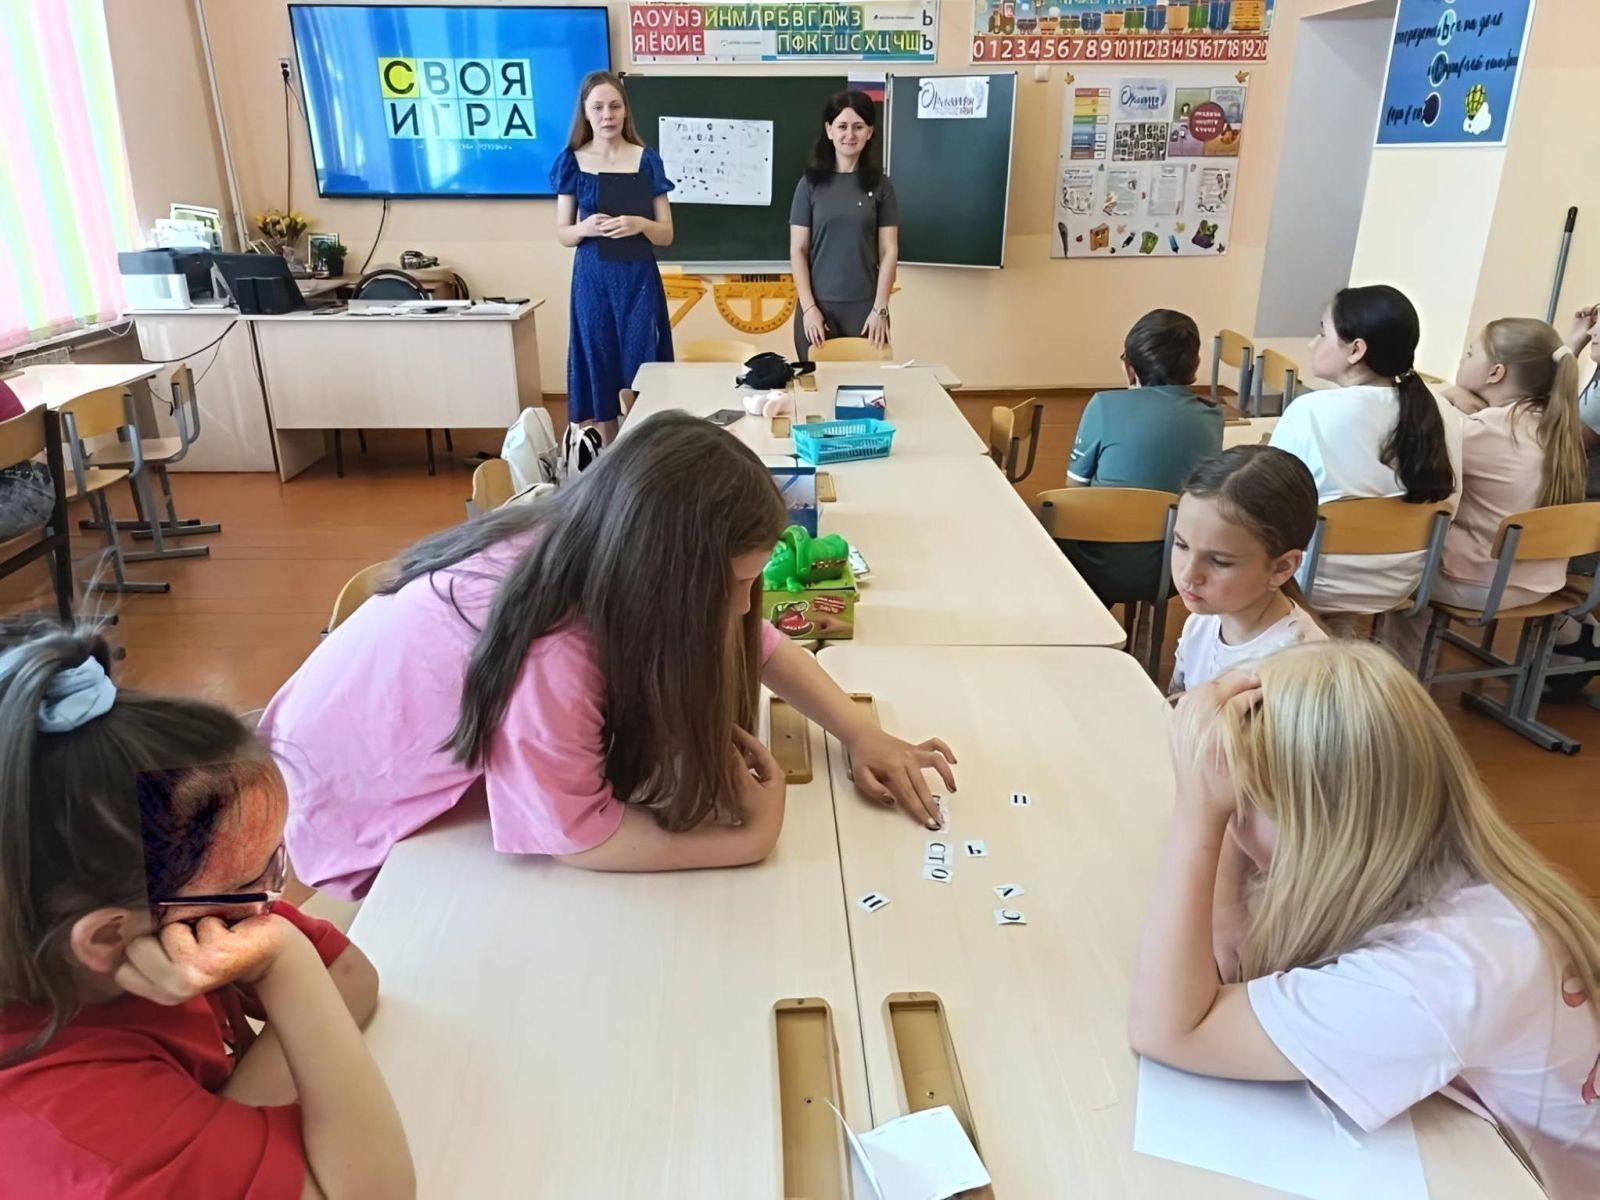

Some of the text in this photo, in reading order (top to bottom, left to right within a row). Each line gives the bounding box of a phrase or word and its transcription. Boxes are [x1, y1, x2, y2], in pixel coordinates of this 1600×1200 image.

[973, 40, 984, 58] 0
[990, 40, 997, 58] 1
[1001, 40, 1013, 58] 2
[1016, 40, 1026, 58] 3
[1029, 40, 1040, 58] 4
[1043, 40, 1055, 58] 5
[1058, 40, 1070, 58] 6
[1072, 40, 1084, 58] 7
[1086, 40, 1097, 58] 8
[1100, 40, 1112, 58] 9
[1114, 40, 1127, 58] 10
[1129, 40, 1140, 58] 11
[1143, 40, 1155, 58] 12
[1157, 40, 1169, 58] 13
[1172, 40, 1183, 58] 14
[1185, 40, 1198, 58] 15
[1199, 40, 1212, 58] 16
[1213, 40, 1226, 58] 17
[1227, 40, 1240, 58] 18
[1241, 40, 1254, 58] 19
[384, 60, 527, 96] СВОЯ
[390, 102, 533, 137] ИГРА
